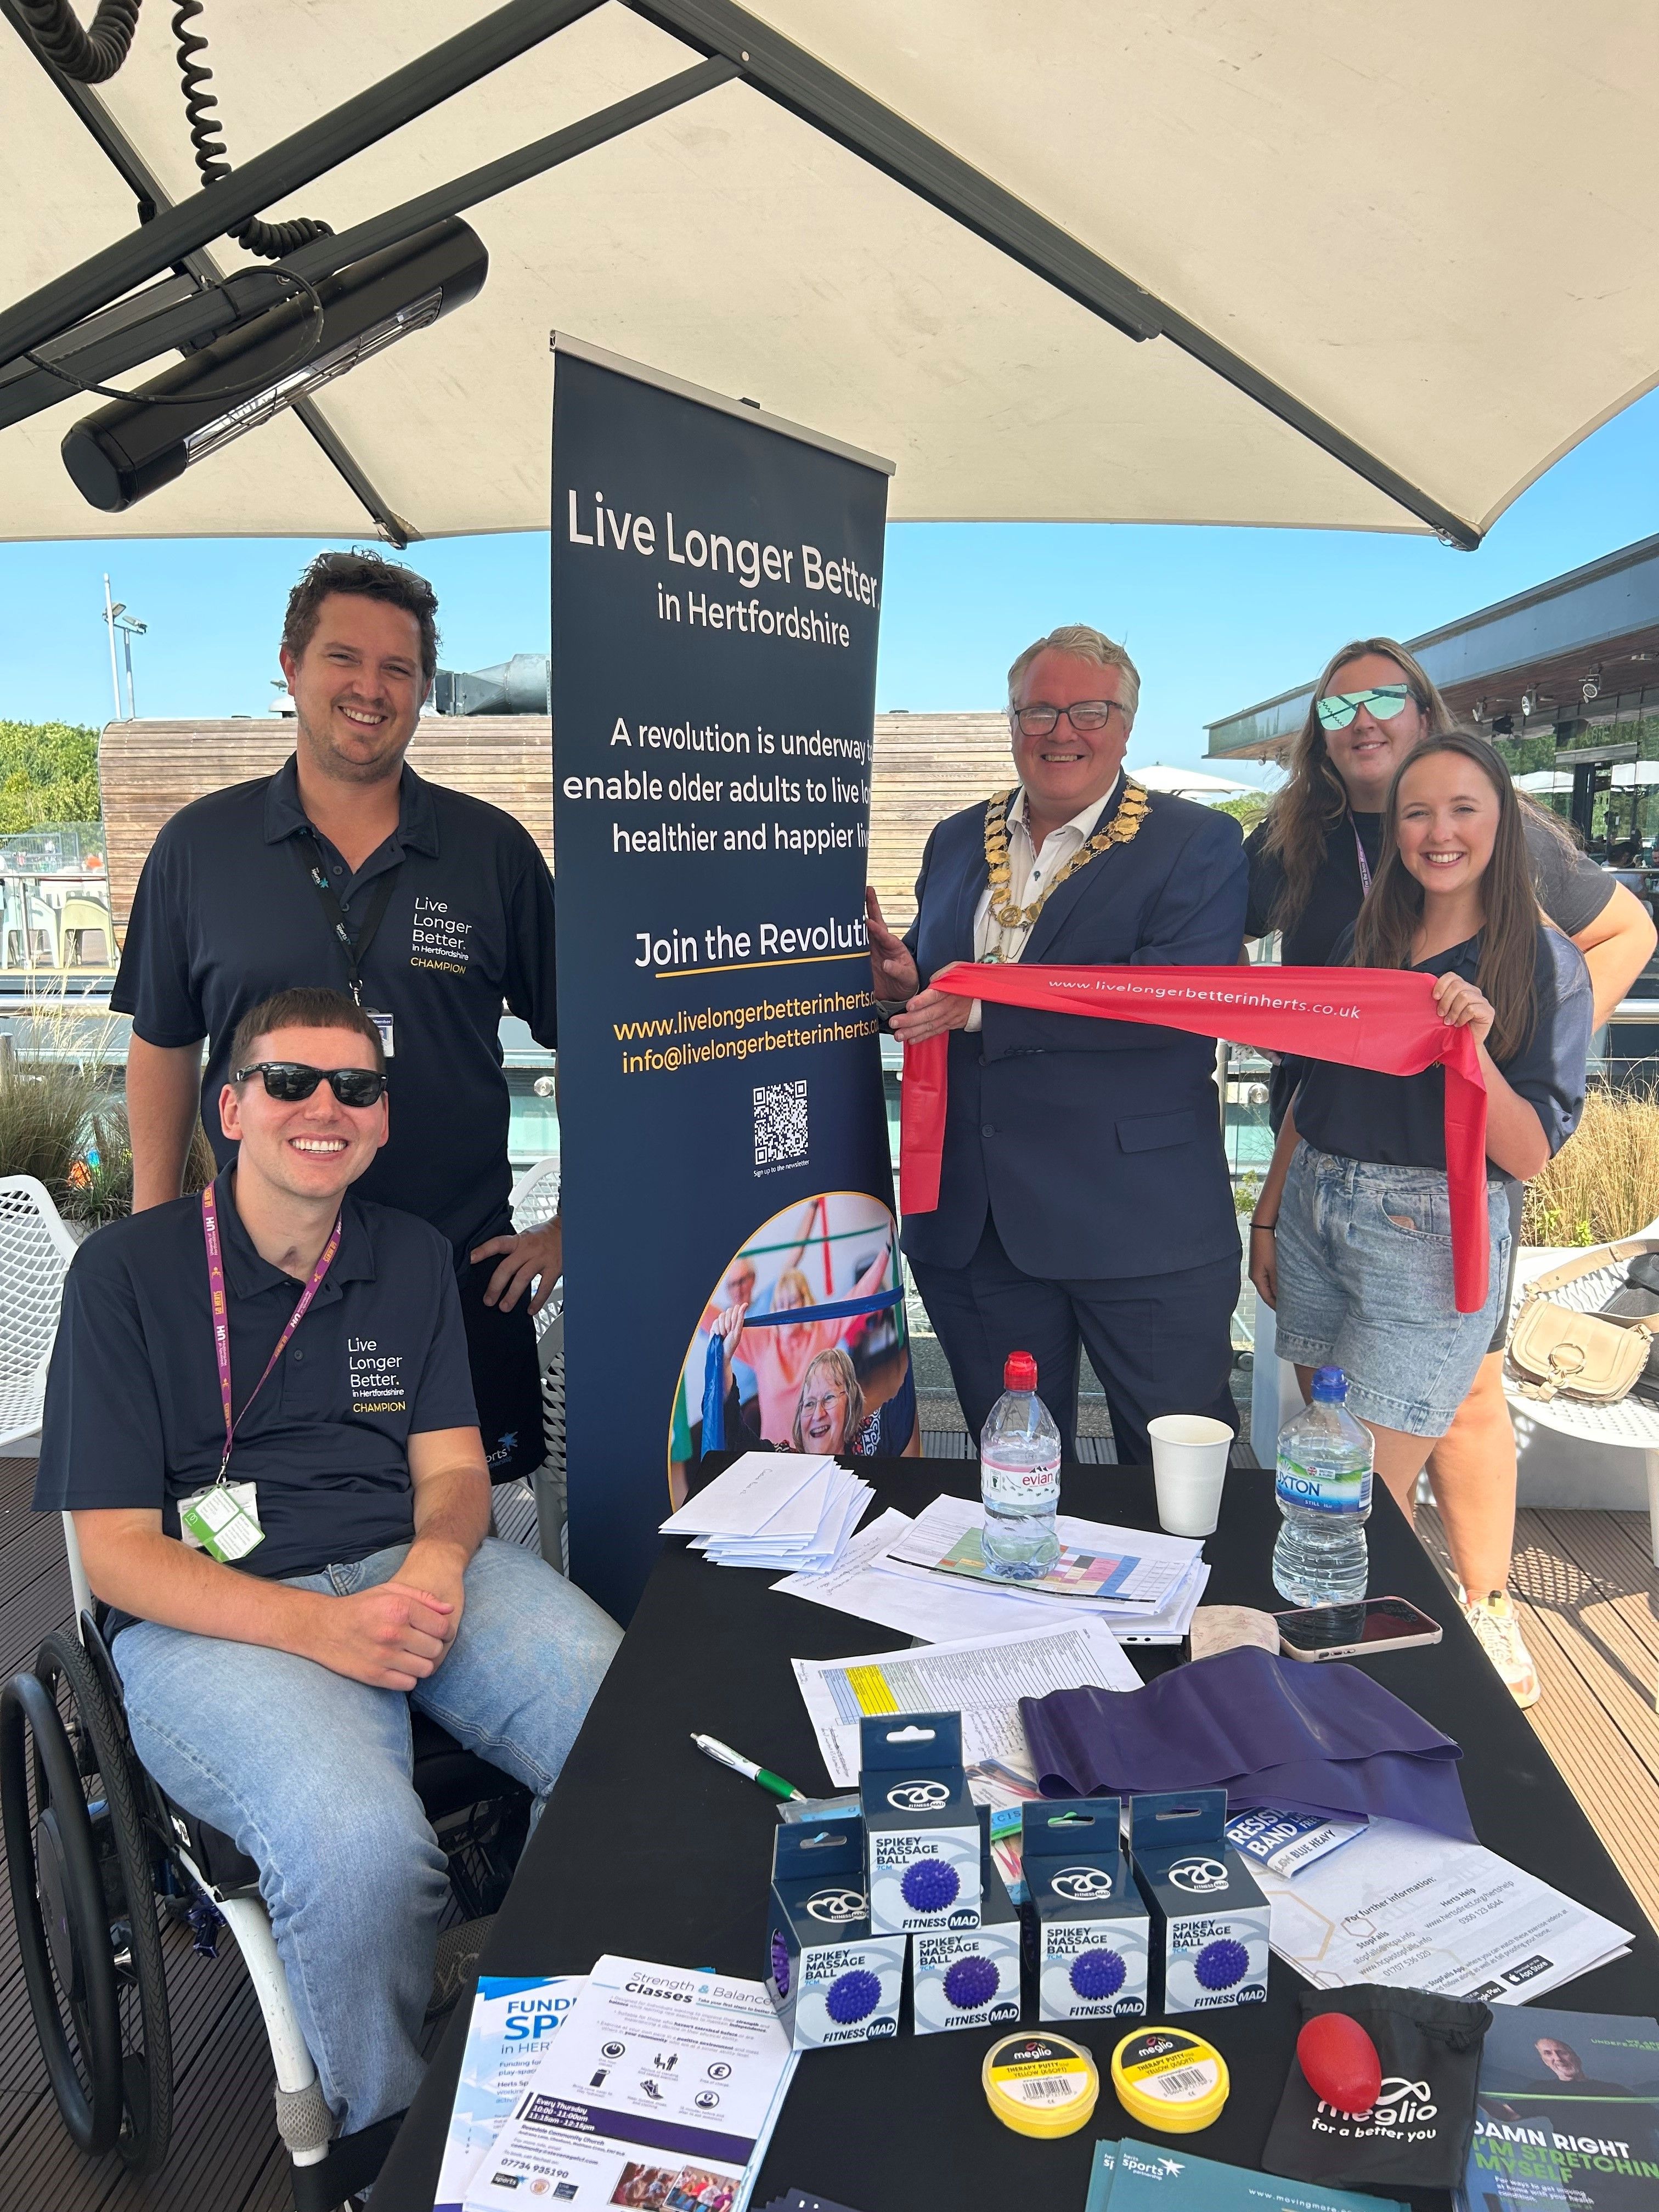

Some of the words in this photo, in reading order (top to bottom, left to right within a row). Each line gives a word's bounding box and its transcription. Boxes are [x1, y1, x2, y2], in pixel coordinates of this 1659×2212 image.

[569, 490, 655, 555] Live
[667, 512, 793, 588] Longer
[658, 583, 680, 622] in
[689, 591, 850, 647] Hertfordshire
[611, 718, 632, 747] A
[639, 722, 750, 753] revolution
[758, 726, 775, 754] is
[781, 730, 866, 766] underway
[563, 770, 662, 801] enable
[668, 772, 723, 802] older
[730, 775, 800, 803] adults
[806, 780, 827, 804] to
[832, 777, 859, 805] live
[613, 823, 716, 853] healthier
[724, 823, 766, 851] and
[774, 822, 854, 855] happier
[312, 868, 321, 884] sports
[415, 896, 448, 913] Live
[336, 924, 348, 940] sports
[414, 913, 472, 934] Longer
[413, 929, 466, 950] Better.
[635, 928, 697, 968] Join
[706, 925, 751, 961] the
[421, 945, 469, 961] Hertfordshire
[410, 957, 466, 974] CHAMPION
[1048, 980, 1361, 1019] www.livelongerbetterinherts.co.uk
[753, 1170, 764, 1178] Sign
[785, 1160, 810, 1170] newsletter
[205, 1216, 216, 1231] UH
[213, 1291, 222, 1307] HERTS
[290, 1313, 301, 1328] UH
[217, 1325, 226, 1341] UH
[348, 1337, 377, 1352] Live
[349, 1356, 403, 1372] Longer
[351, 1374, 399, 1387] Better.
[352, 1389, 359, 1397] in
[360, 1388, 404, 1397] Hertfordshire
[353, 1401, 406, 1413] CHAMPION
[1022, 1473, 1053, 1486] evian
[876, 1836, 922, 1847] SPIKEY
[1246, 1822, 1298, 1858] BAND
[1290, 1844, 1313, 1859] BLUE
[1309, 1829, 1336, 1851] HEAVY
[876, 1844, 939, 1856] MASSAGE
[876, 1855, 910, 1865] BALL
[1344, 1912, 1359, 1923] For
[1358, 1899, 1389, 1918] further
[1389, 1876, 1437, 1903] information:
[1440, 1895, 1460, 1908] Herts
[1460, 1887, 1476, 1899] Help
[1458, 1913, 1477, 1925] 0300
[1475, 1907, 1488, 1918] 123
[1487, 1899, 1504, 1911] 4044
[902, 1918, 946, 1929] FITNESS
[949, 1915, 979, 1927] MAD
[1173, 1920, 1216, 1932] SPIKEY
[1047, 1928, 1091, 1937] SPIKEY
[1047, 1935, 1107, 1945] MASSAGE
[1173, 1926, 1231, 1940] MASSAGE
[1356, 1931, 1390, 1949] StopFalls
[919, 1936, 963, 1948] SPIKEY
[919, 1942, 980, 1957] MASSAGE
[1047, 1945, 1079, 1955] BALL
[1173, 1937, 1204, 1948] BALL
[1353, 1931, 1416, 1965] stopfalls@hcpa.info
[806, 1949, 851, 1962] SPIKEY
[806, 1955, 866, 1970] MASSAGE
[919, 1955, 952, 1966] BALL
[1358, 1936, 1432, 1976] www.hcpastopfalls.info
[1383, 1962, 1405, 1977] 01707
[1404, 1957, 1418, 1967] 536
[1418, 1950, 1431, 1960] 020
[805, 1968, 837, 1980] BALL
[1427, 1971, 1454, 1987] StopFalls
[1453, 1965, 1465, 1976] App
[1519, 1967, 1532, 1980] App
[1530, 1961, 1548, 1973] Store
[631, 1971, 695, 1993] Strength
[698, 1984, 709, 1994] &
[625, 1982, 694, 2004] Classes
[1194, 1995, 1235, 2007] FITNESS
[1238, 1990, 1265, 2002] MAD
[1487, 1986, 1502, 1997] Play
[945, 2012, 988, 2027] FITNESS
[990, 2008, 1019, 2021] MAD
[1070, 2005, 1113, 2017] FITNESS
[1115, 2003, 1144, 2015] MAD
[504, 2014, 568, 2041] SP
[823, 2028, 866, 2043] FITNESS
[866, 2022, 896, 2038] MAD
[501, 2044, 514, 2055] in
[518, 2041, 554, 2053] HER
[1014, 2047, 1052, 2060] meglio
[1138, 2040, 1173, 2057] meglio
[1007, 2064, 1036, 2073] THERAPY
[1137, 2059, 1165, 2072] THERAPY
[1165, 2052, 1185, 2063] PUTTY
[532, 2104, 554, 2115] 10:00
[558, 2111, 589, 2123] 11:00am
[536, 2097, 556, 2109] Every
[556, 2102, 588, 2115] Thursday
[548, 2129, 582, 2142] Community
[583, 2136, 605, 2146] Church
[1312, 2117, 1336, 2134] for
[1339, 2127, 1350, 2136] a
[1354, 2126, 1404, 2140] better
[1407, 2129, 1437, 2143] you
[1472, 2136, 1515, 2158] I'M
[1551, 2131, 1630, 2159] RIGHT
[501, 2158, 531, 2171] 07734
[1124, 2153, 1139, 2162] herts
[1122, 2158, 1164, 2176] sports
[1133, 2170, 1163, 2181] partnership
[1474, 2152, 1573, 2183] MYSELF
[494, 2176, 517, 2186] sports
